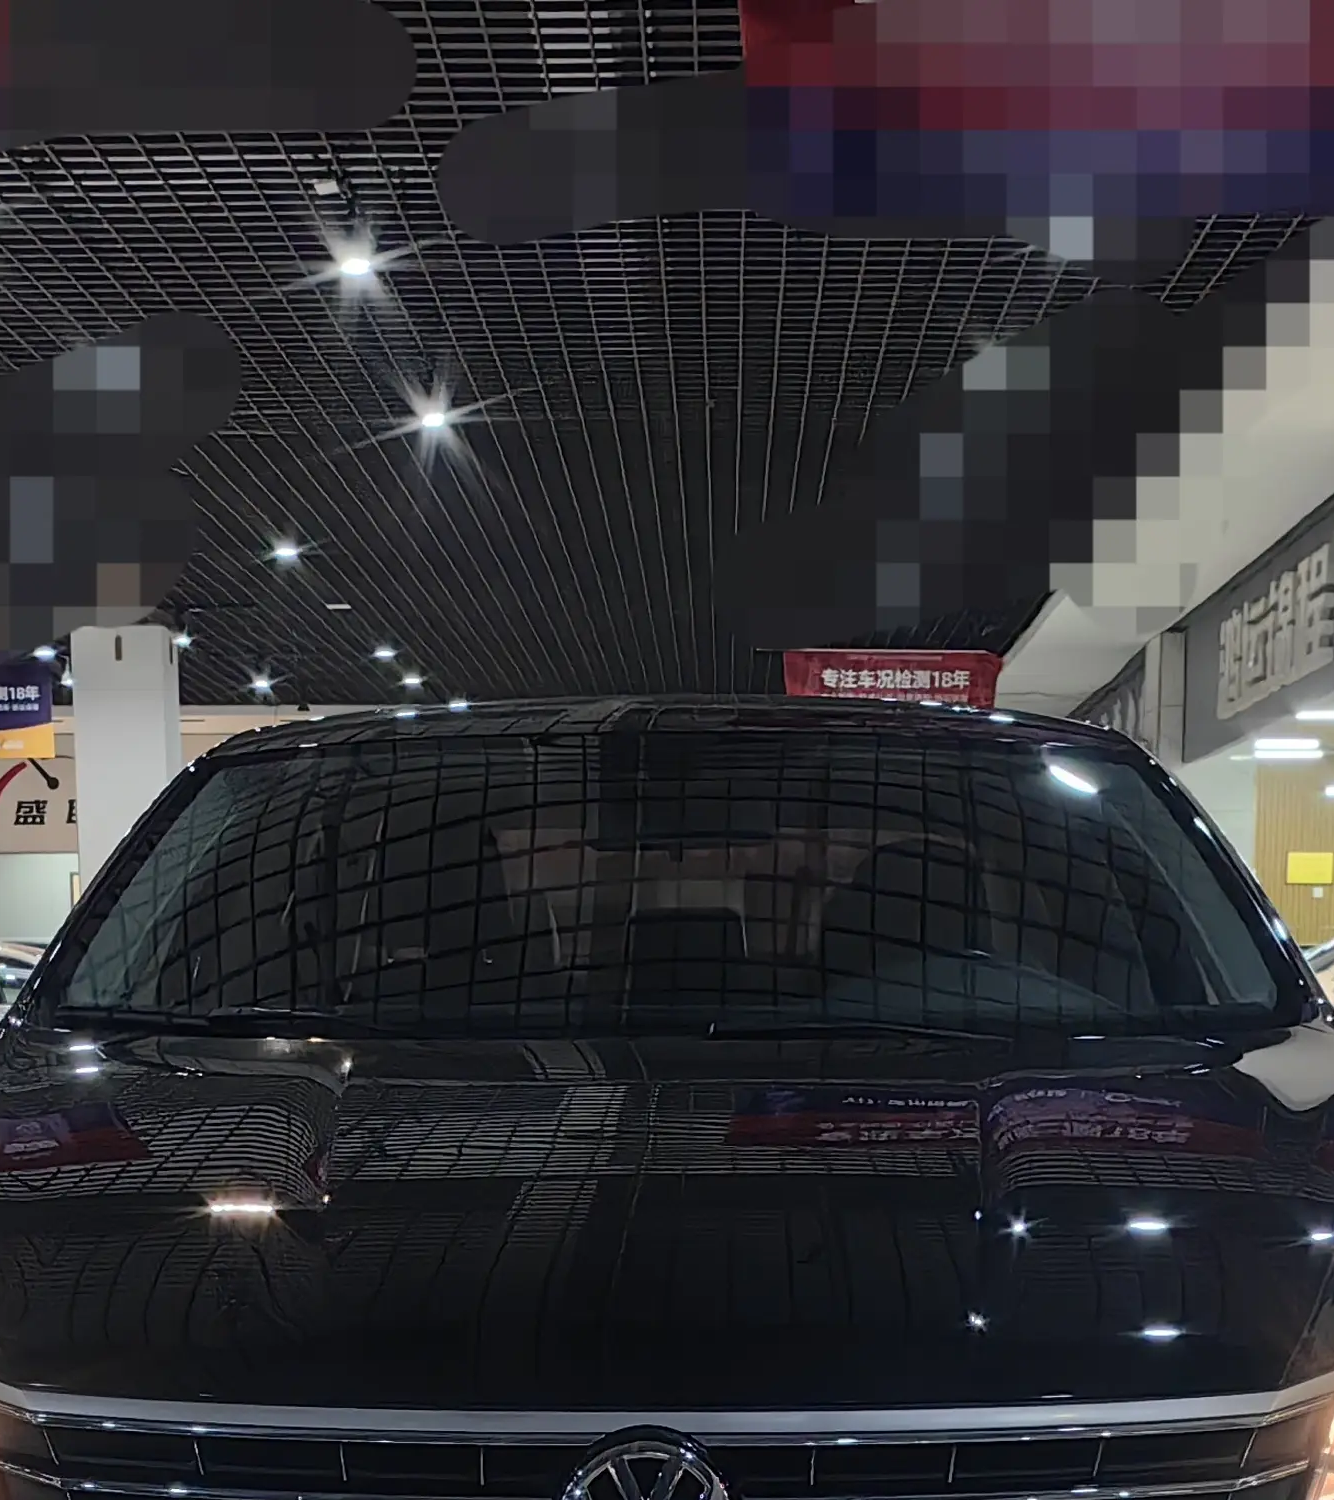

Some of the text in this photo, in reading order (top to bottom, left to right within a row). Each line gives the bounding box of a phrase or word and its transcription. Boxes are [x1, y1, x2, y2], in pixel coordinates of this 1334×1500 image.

[821, 668, 970, 690] 专注车况检测18年
